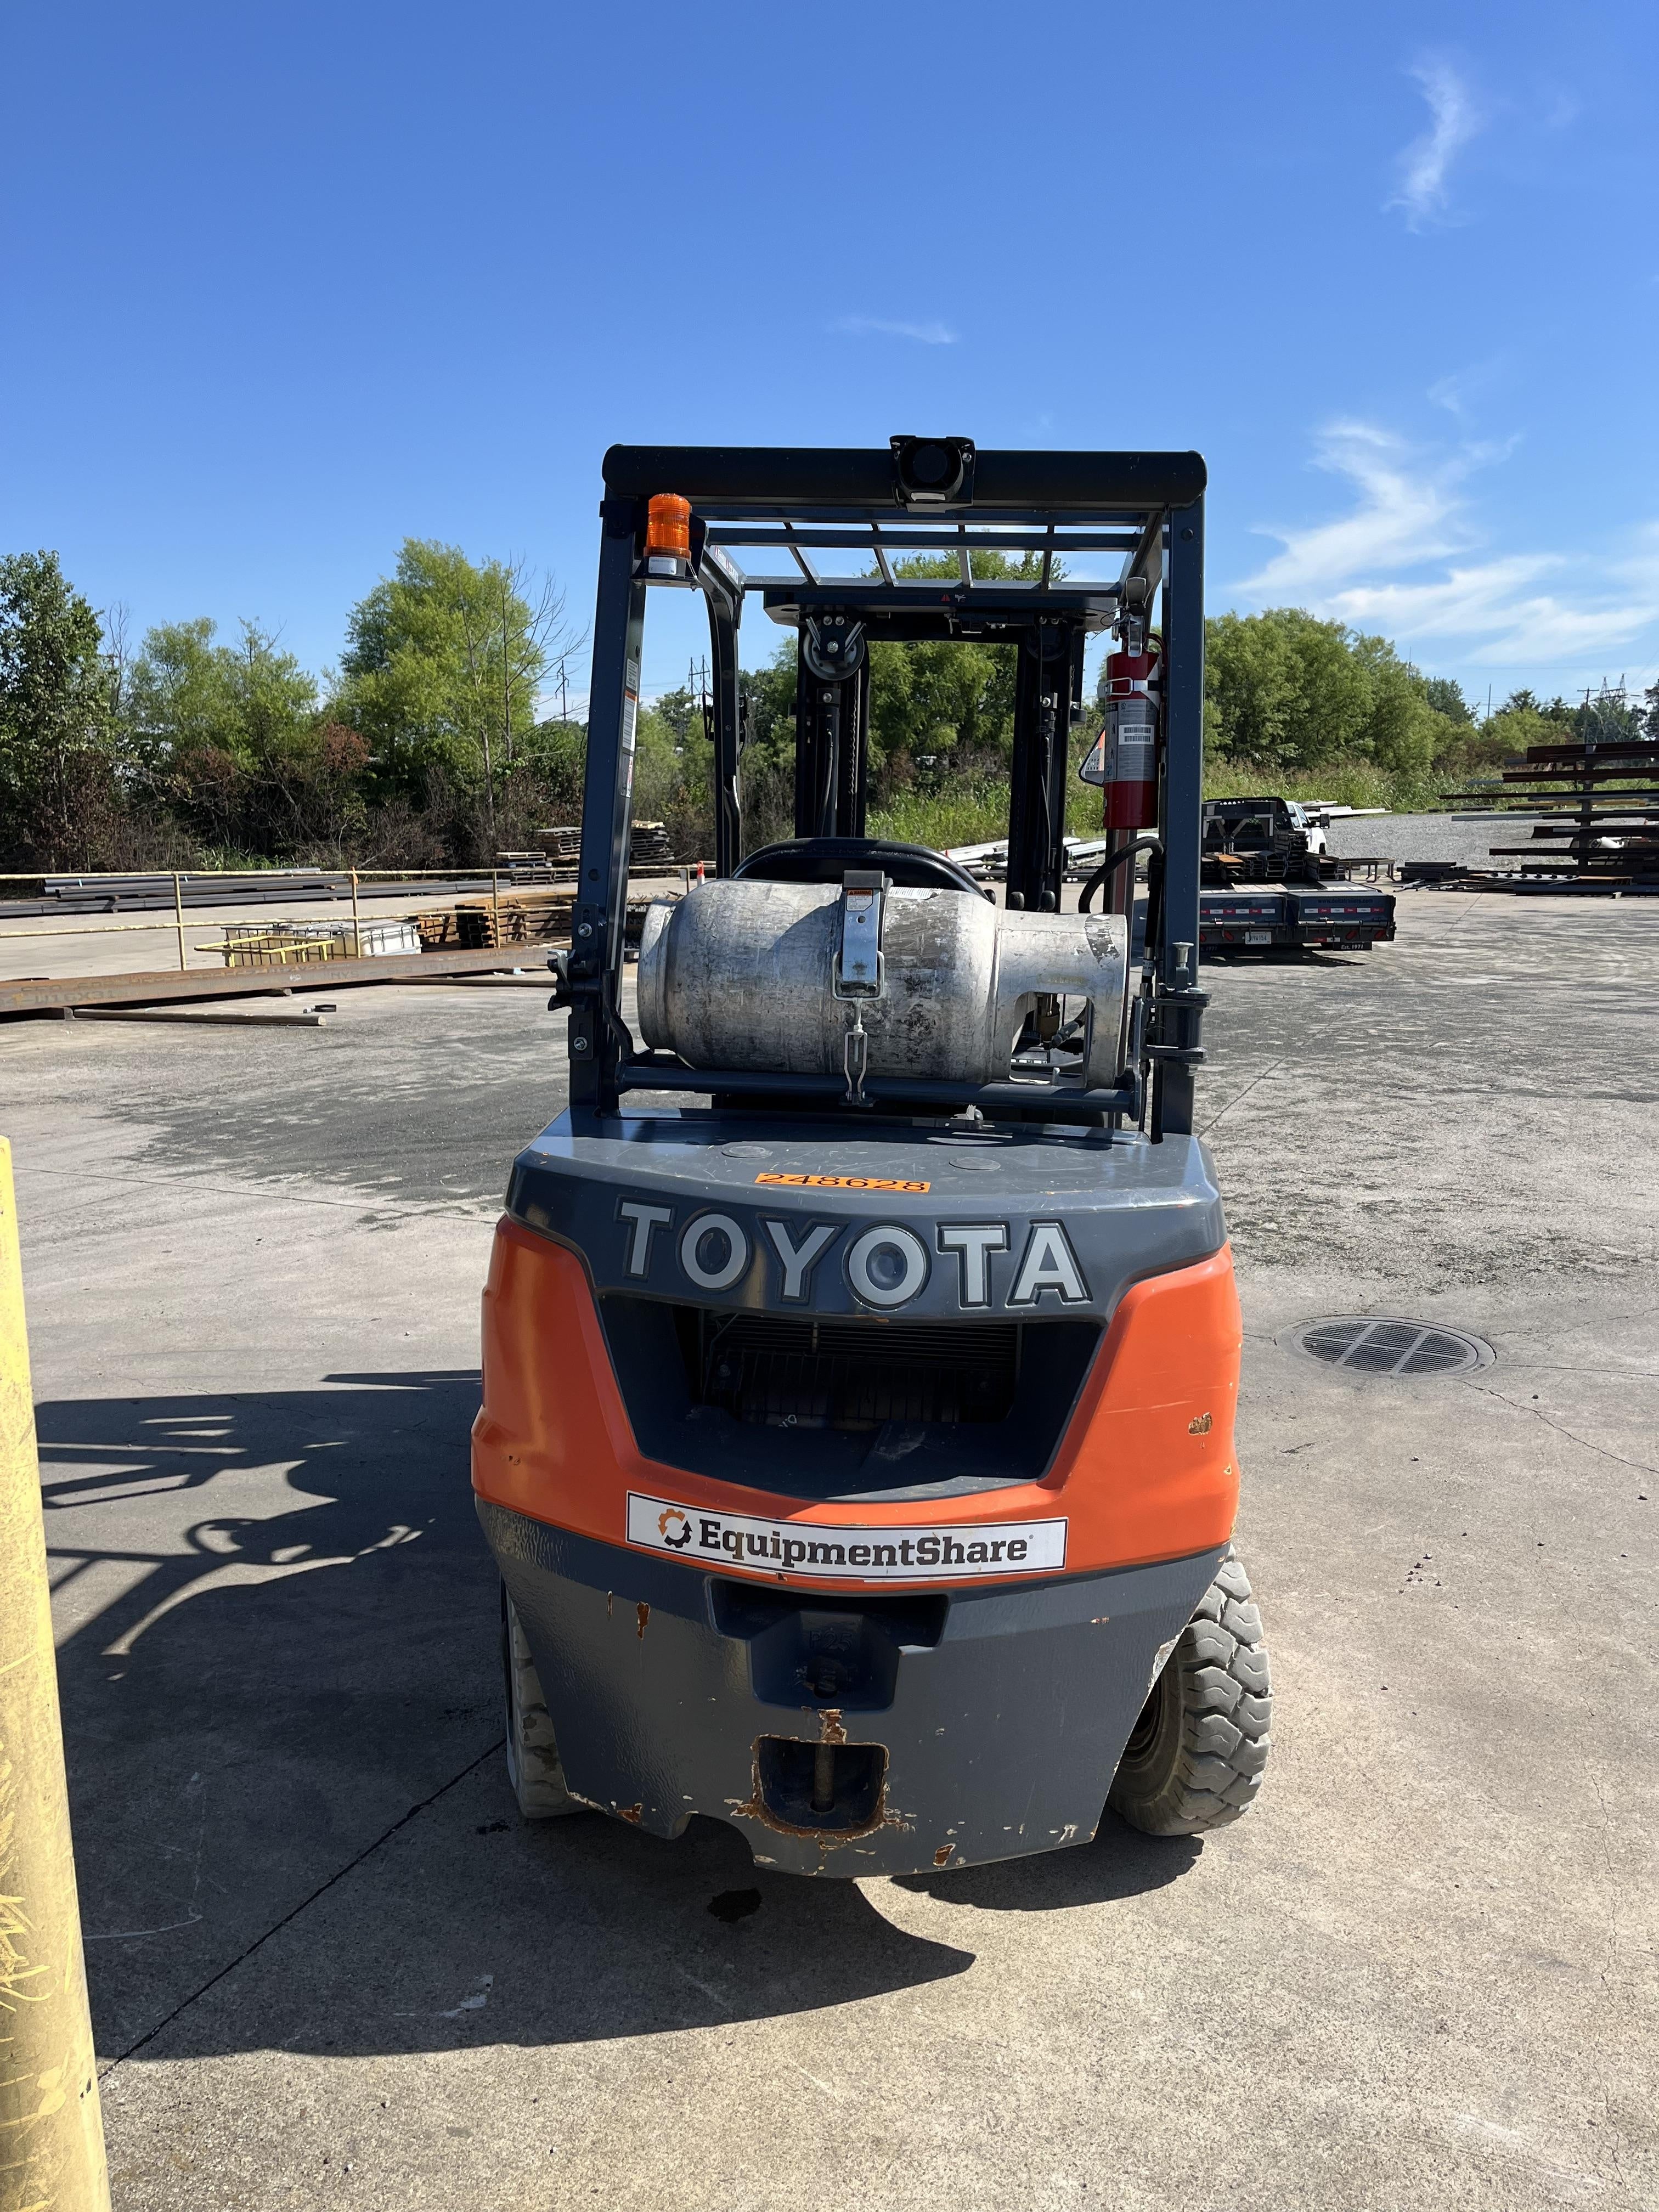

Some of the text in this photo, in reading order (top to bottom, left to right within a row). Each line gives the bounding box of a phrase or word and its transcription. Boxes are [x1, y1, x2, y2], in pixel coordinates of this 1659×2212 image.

[759, 1173, 925, 1191] 248628
[620, 1203, 1086, 1306] TOYOTA
[699, 1519, 1027, 1568] EquipmentShare
